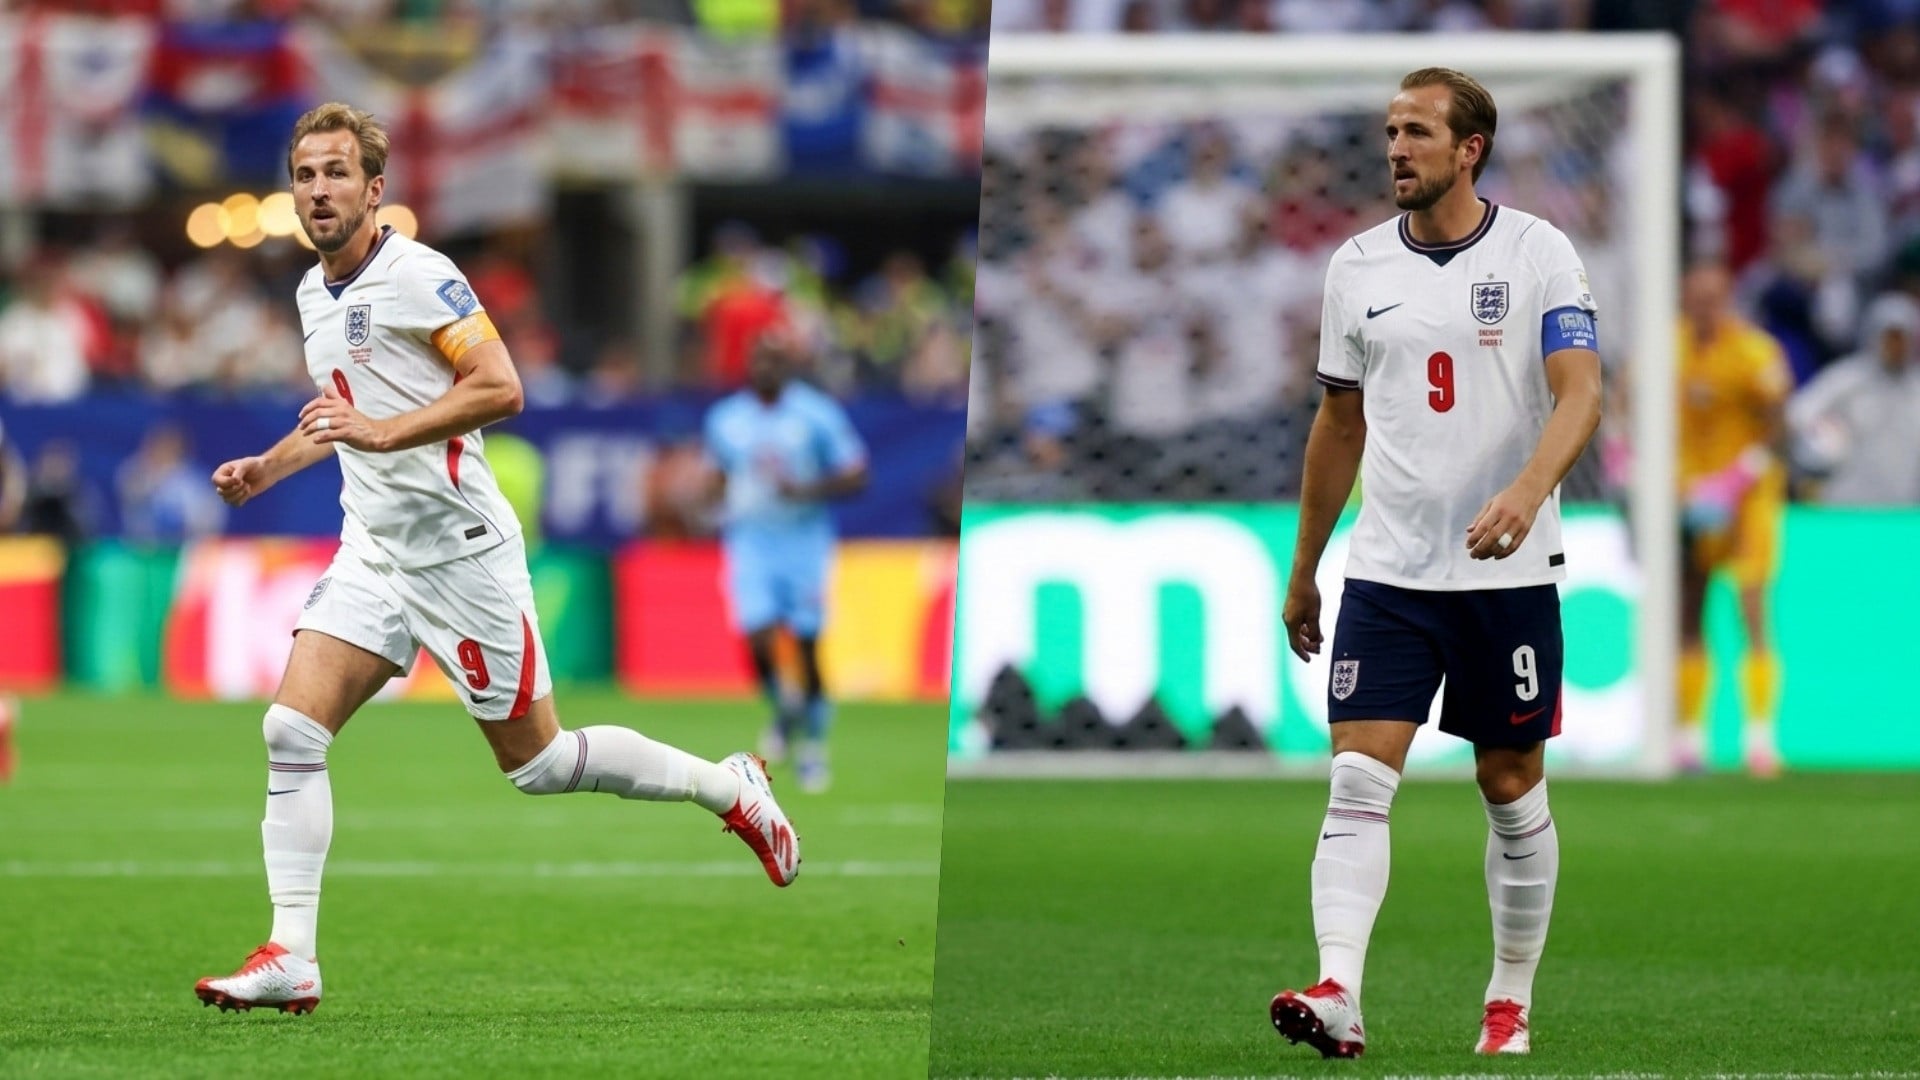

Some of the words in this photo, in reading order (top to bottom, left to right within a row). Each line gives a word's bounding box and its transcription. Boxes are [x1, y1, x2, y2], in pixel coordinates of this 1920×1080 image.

[1427, 351, 1455, 413] 9
[457, 638, 491, 691] 9
[1512, 644, 1539, 701] 9
